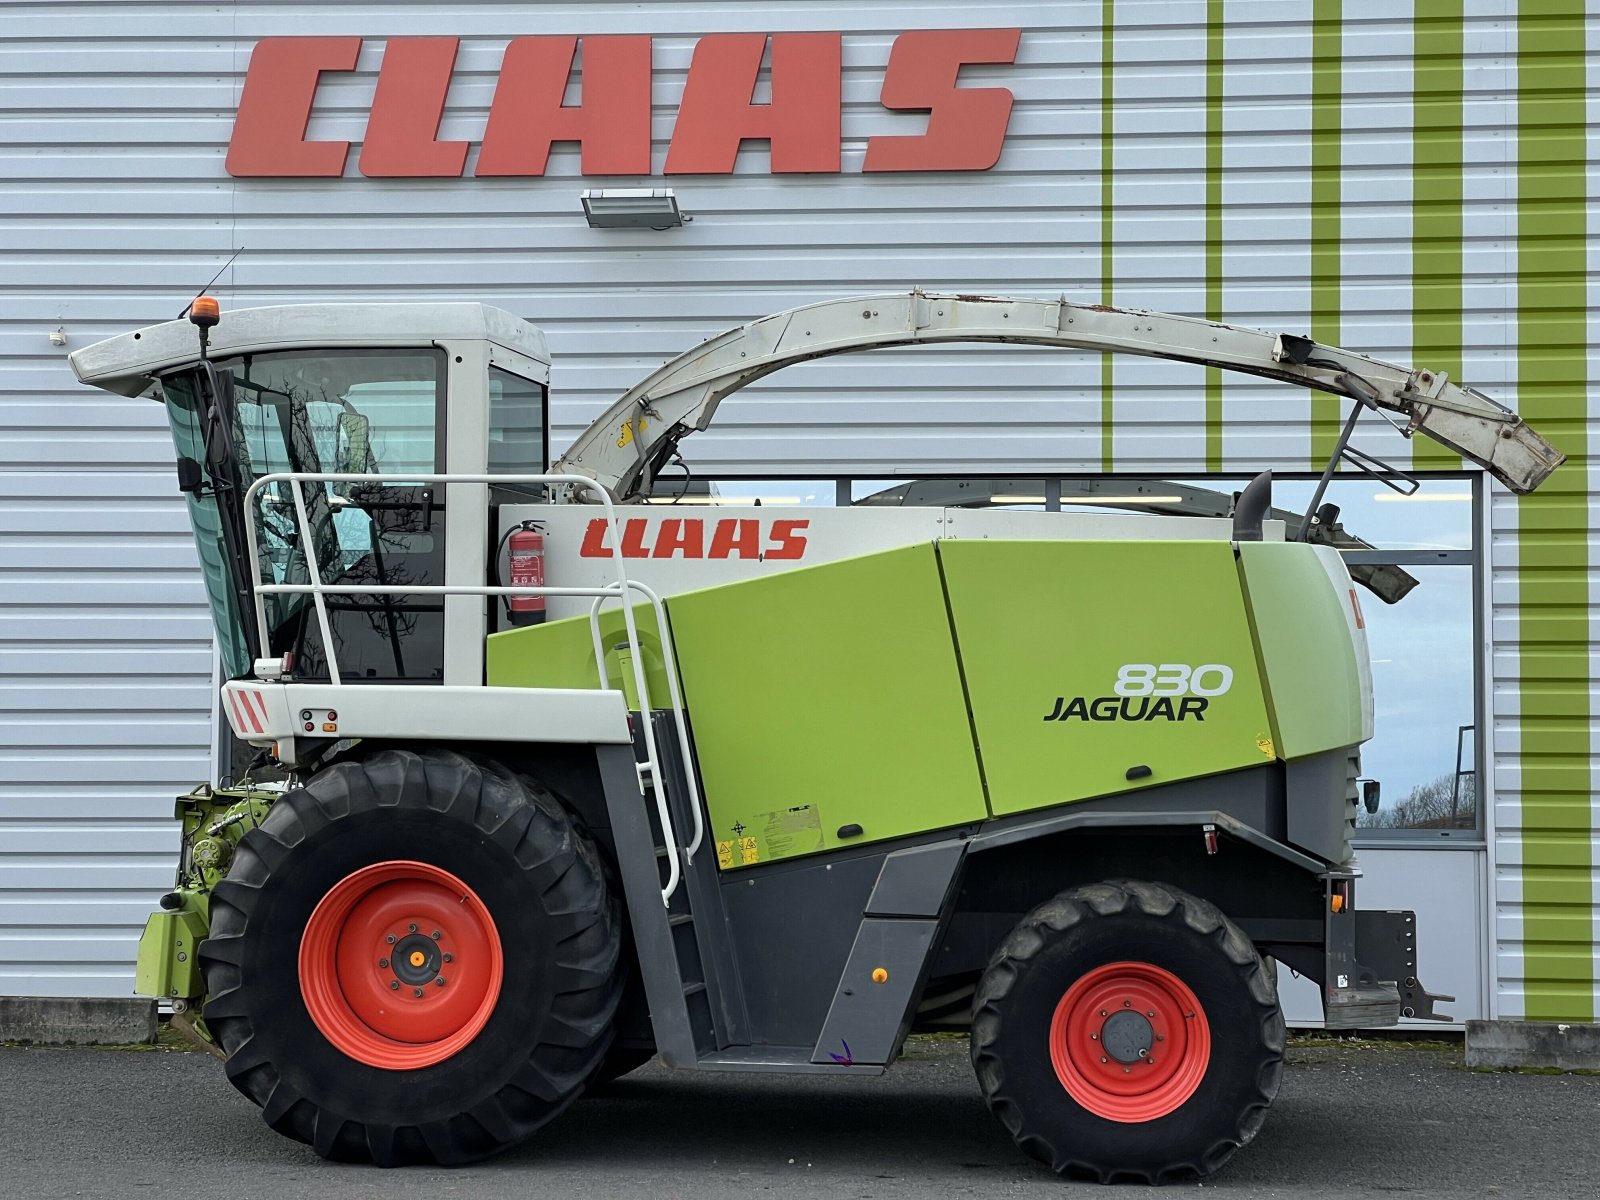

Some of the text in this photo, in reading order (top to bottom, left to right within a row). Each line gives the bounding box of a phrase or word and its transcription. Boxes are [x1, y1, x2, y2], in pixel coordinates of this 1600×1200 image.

[225, 29, 1022, 178] CLAAS
[580, 518, 810, 560] CLAAS
[1113, 663, 1234, 697] 830
[1043, 697, 1209, 721] JAGUAR
